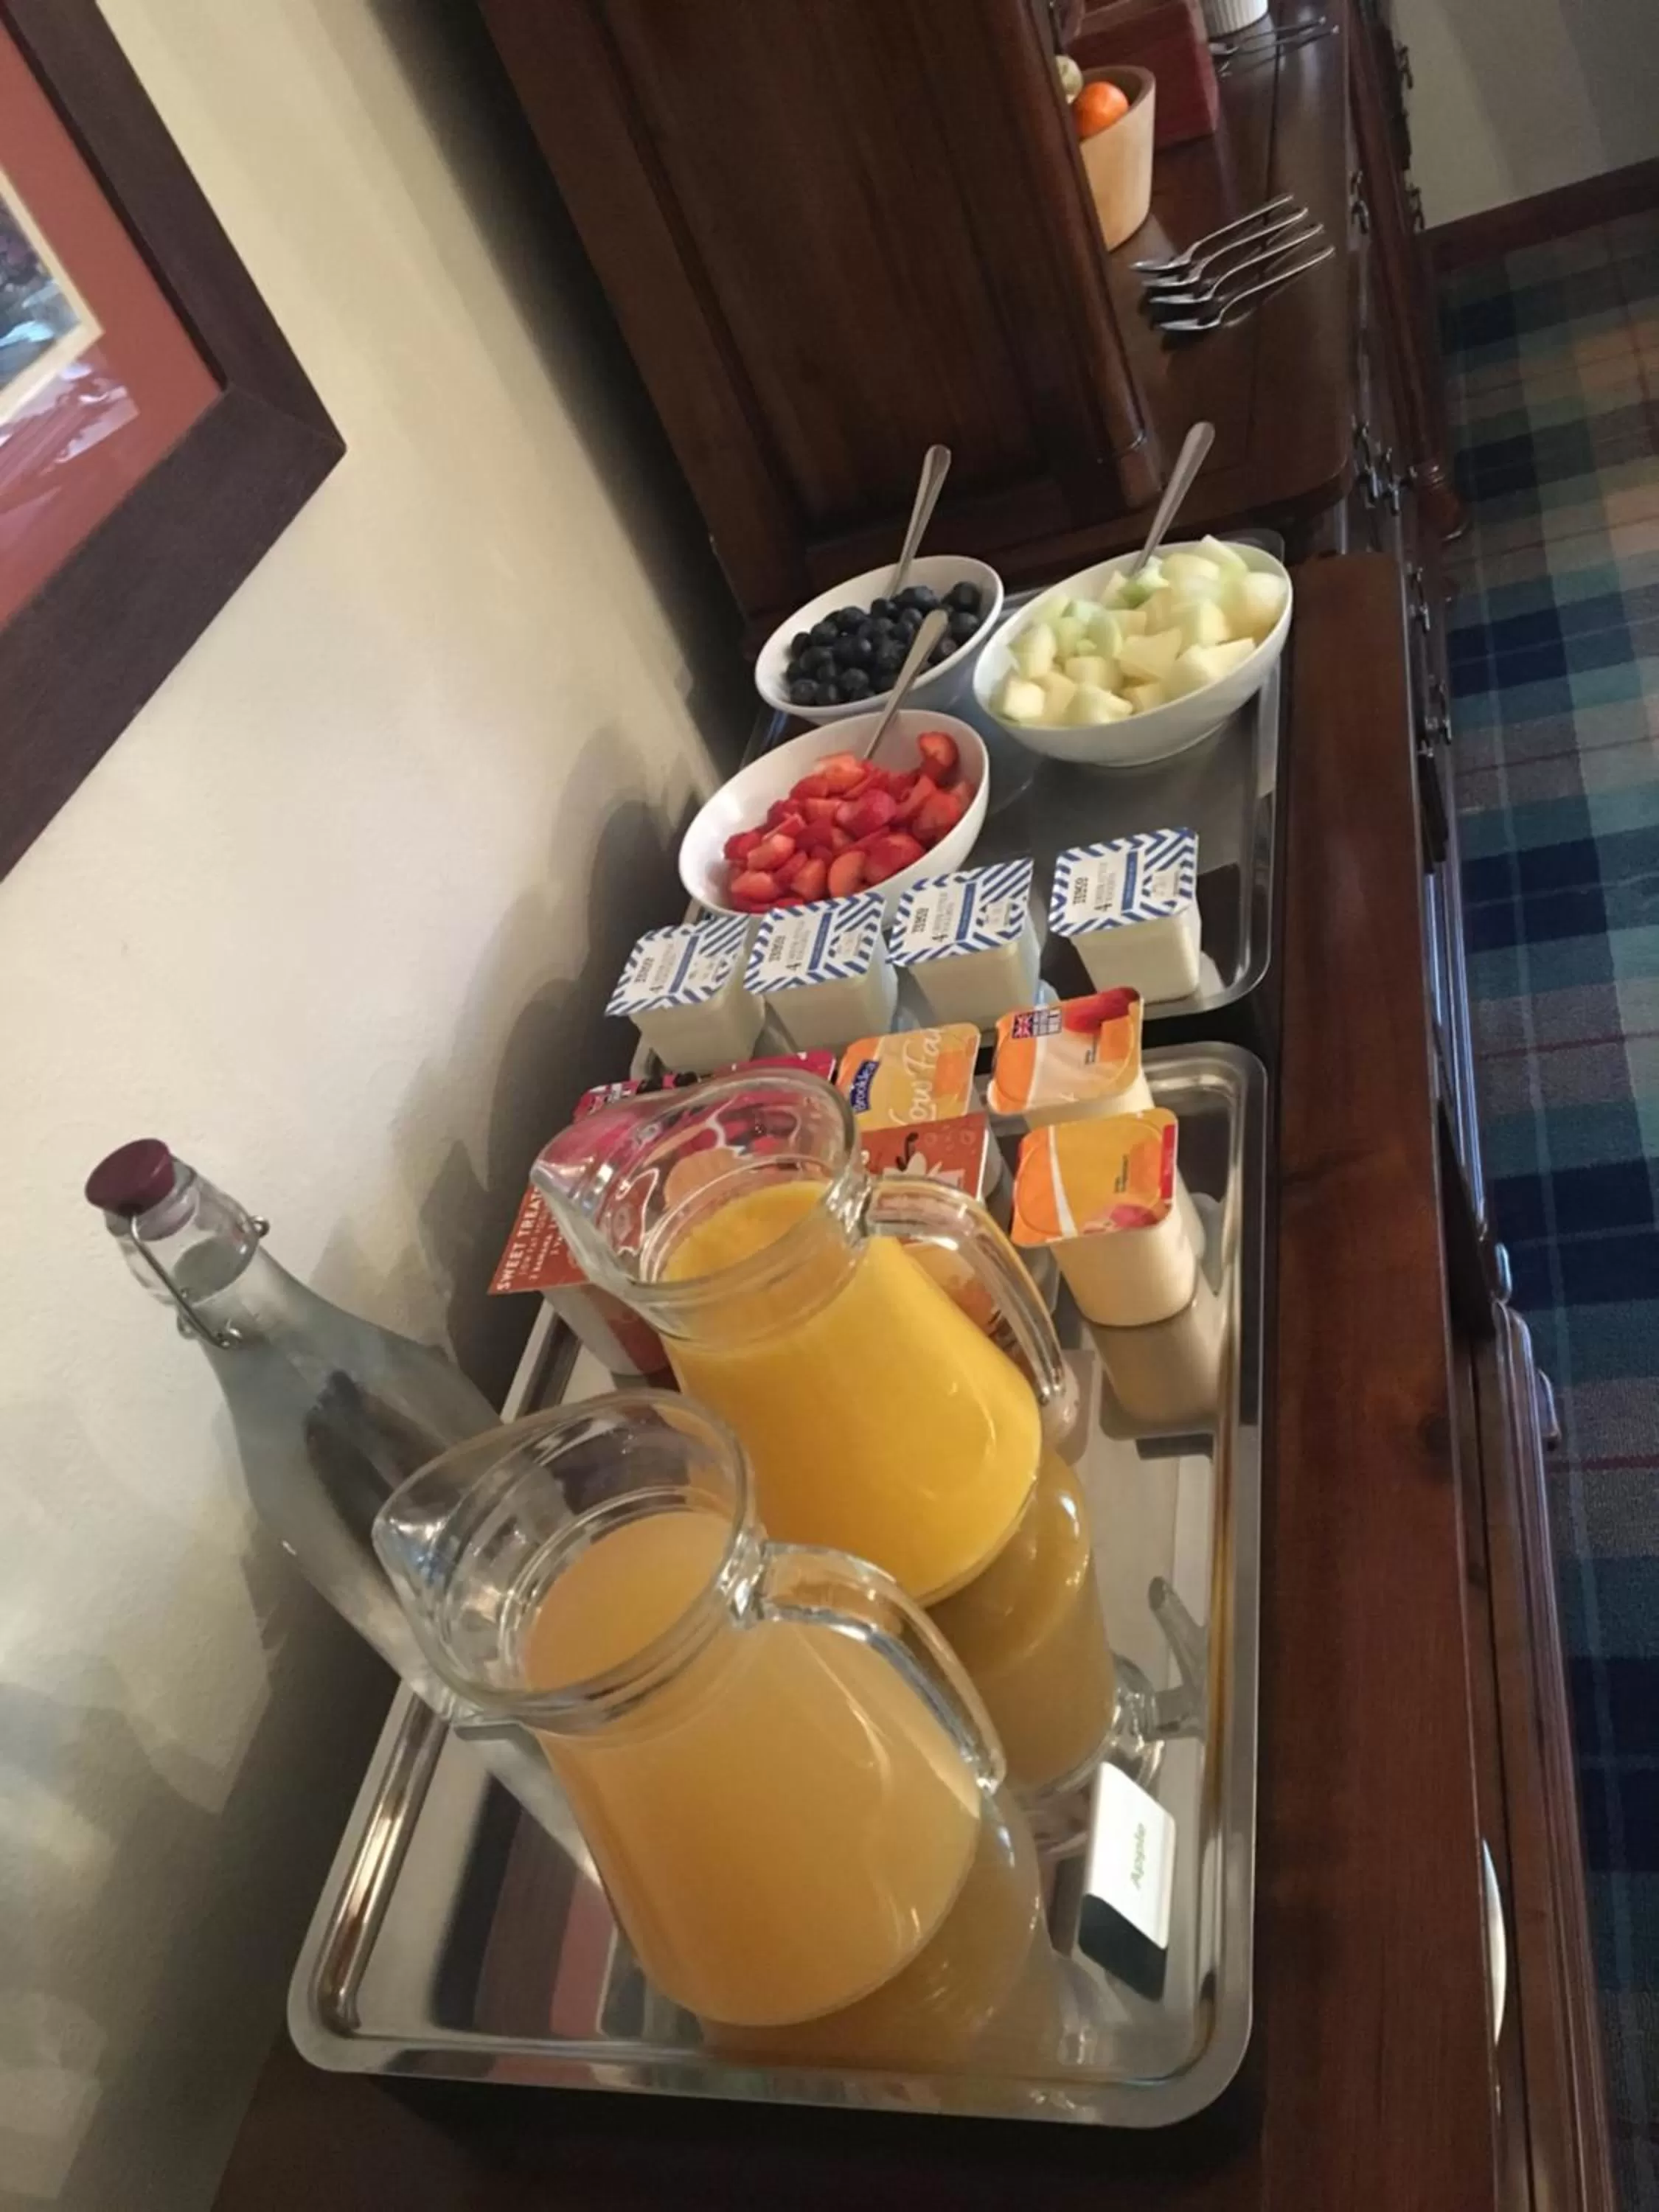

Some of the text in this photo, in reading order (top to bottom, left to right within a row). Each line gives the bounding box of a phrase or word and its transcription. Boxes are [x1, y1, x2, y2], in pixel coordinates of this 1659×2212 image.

[1073, 877, 1089, 905] TESCO
[1094, 902, 1113, 911] 4
[911, 907, 929, 933] TESCO
[931, 933, 949, 942] 4
[785, 962, 801, 971] 4
[497, 1242, 525, 1290] SWEET
[1130, 1822, 1146, 1891] Apple
